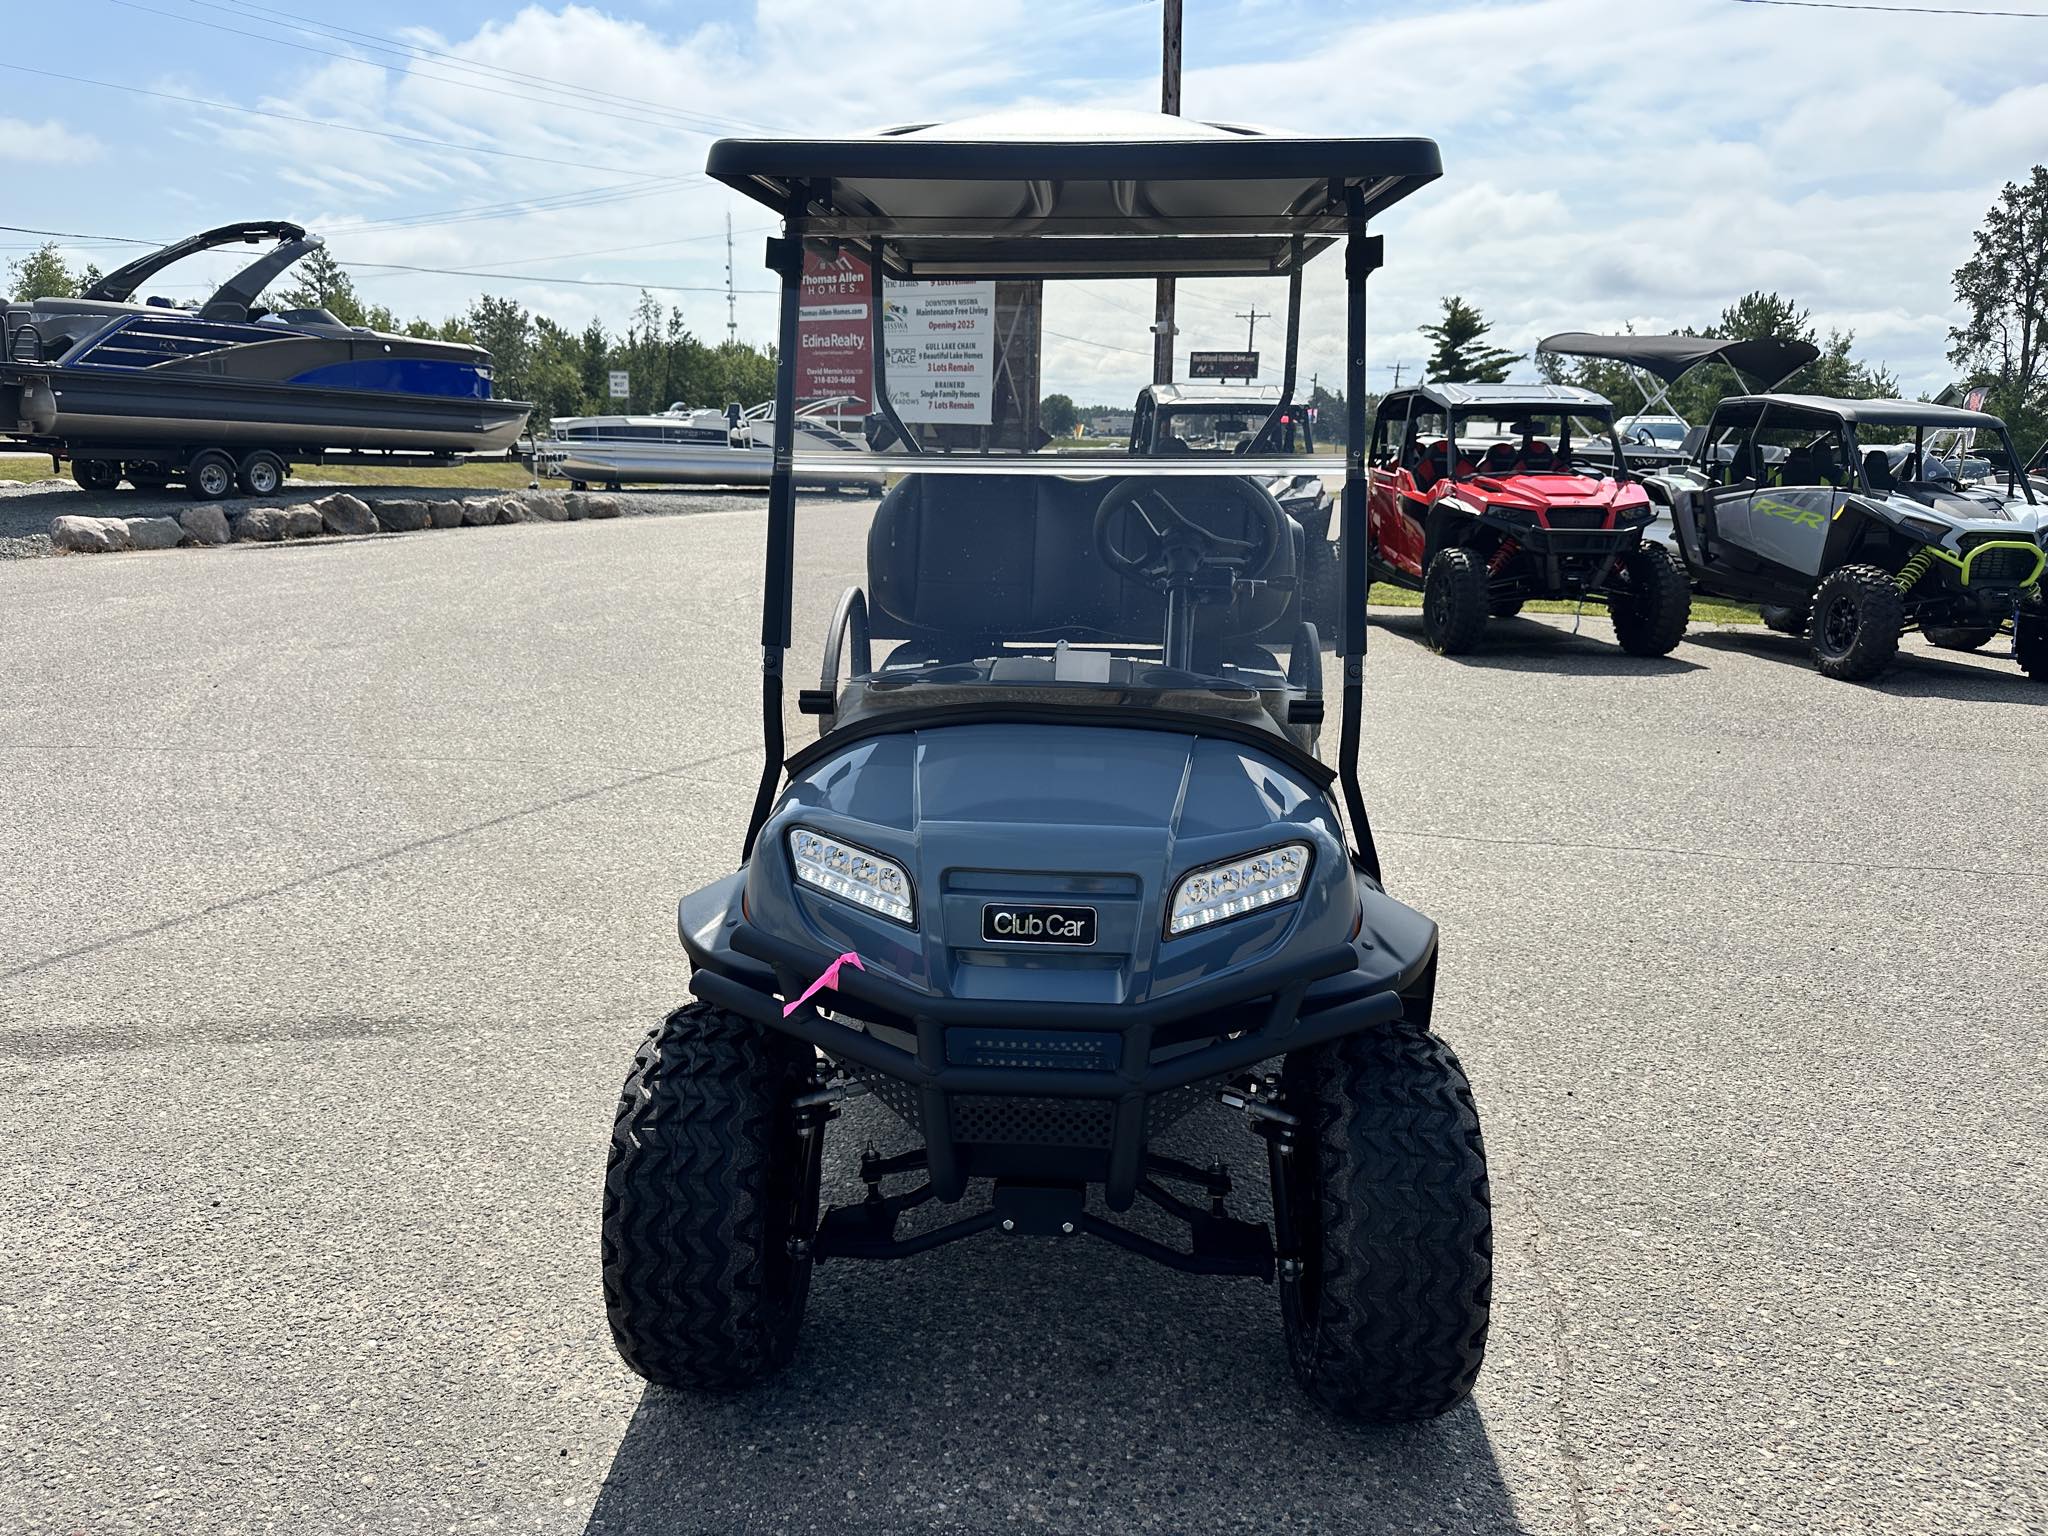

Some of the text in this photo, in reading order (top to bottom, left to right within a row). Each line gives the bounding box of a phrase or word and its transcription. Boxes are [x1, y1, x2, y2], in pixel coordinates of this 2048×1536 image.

[802, 272, 864, 285] Thomas Allen
[808, 283, 855, 295] HOMES
[916, 306, 988, 316] Maintenance Free Living
[928, 320, 975, 331] Opening 2025
[925, 342, 976, 351] GULL LAKE CHAIN
[891, 355, 917, 364] LAKE
[923, 352, 949, 360] Beautiful
[949, 352, 963, 360] Lake
[963, 352, 983, 360] Homes
[927, 363, 932, 372] 3
[933, 362, 947, 372] Lots
[948, 362, 975, 372] Remain
[934, 381, 965, 389] BRAINERD
[920, 390, 980, 400] Single Family Homes
[928, 401, 975, 409] 7 Lots Remain
[1633, 457, 1657, 466] SX22
[1752, 499, 1825, 529] RZR
[993, 912, 1086, 937] Club Car
